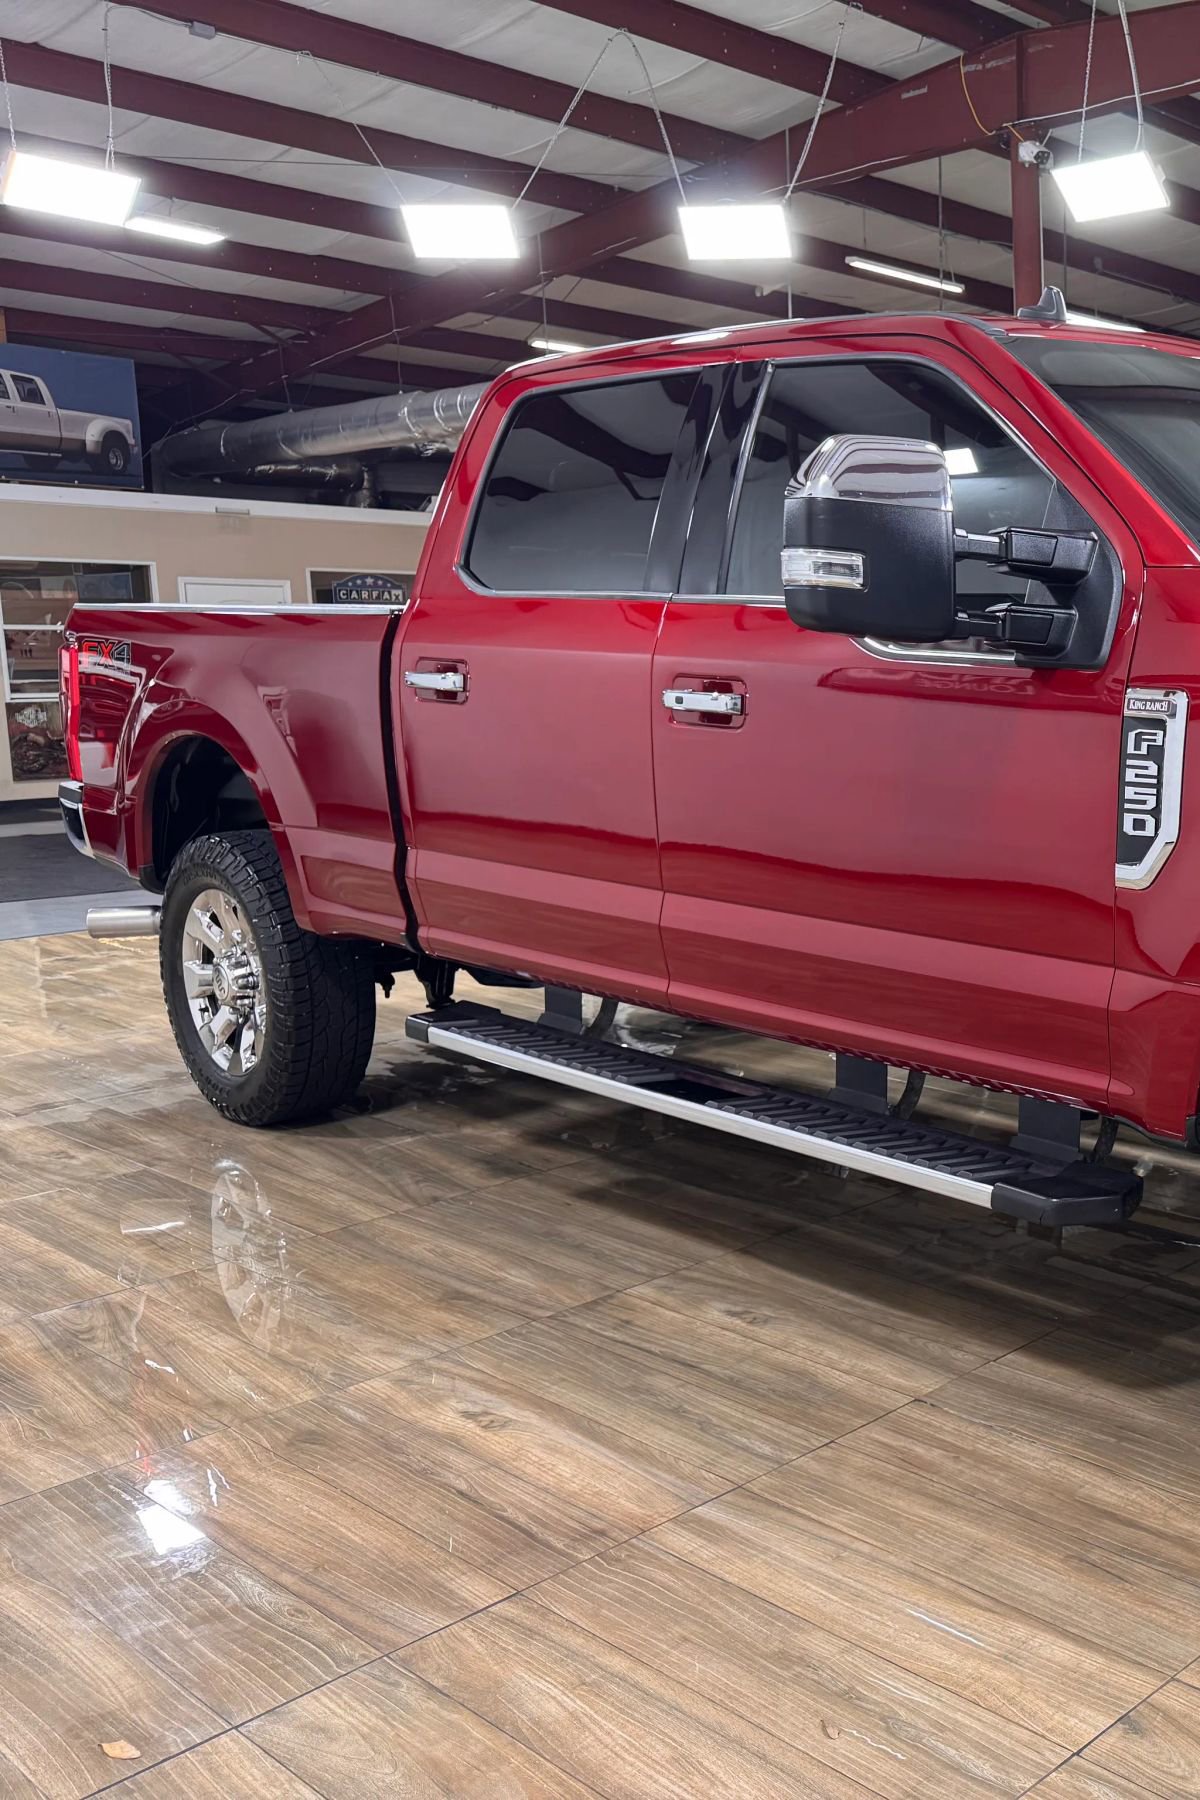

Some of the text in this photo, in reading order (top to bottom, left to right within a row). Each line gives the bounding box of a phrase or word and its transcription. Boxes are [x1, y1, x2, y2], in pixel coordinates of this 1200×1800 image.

[339, 589, 402, 602] CARFAX
[82, 639, 132, 669] FX4
[1129, 699, 1169, 712] KING RANCH
